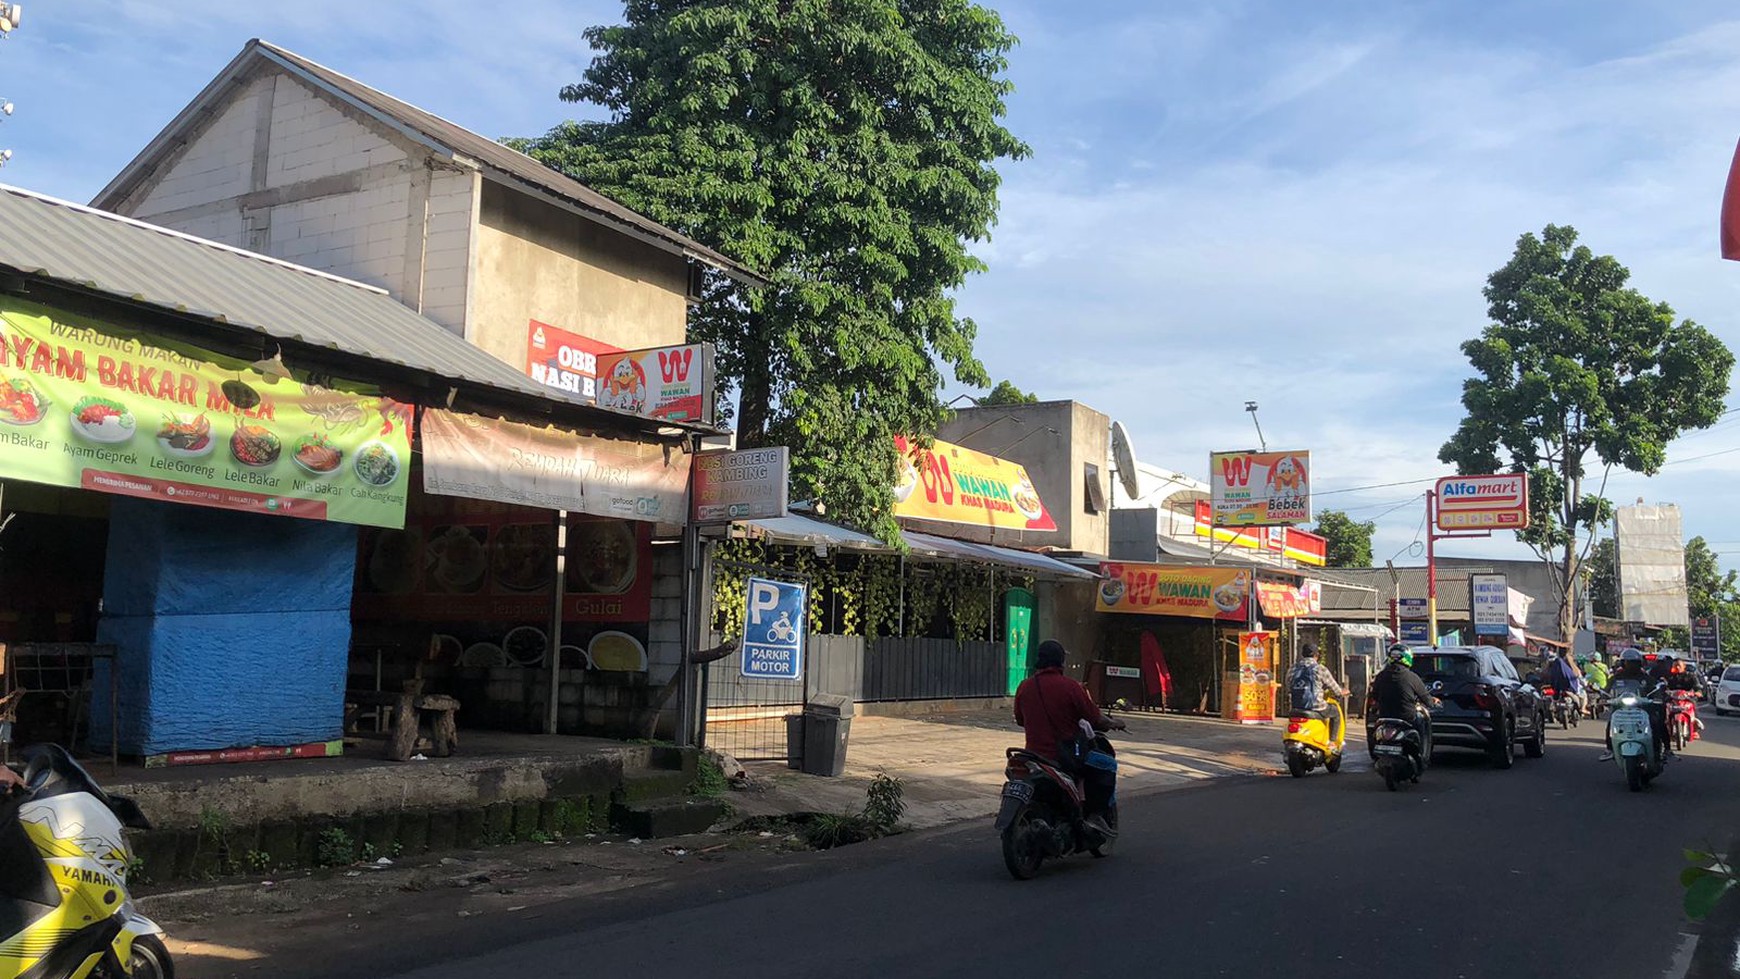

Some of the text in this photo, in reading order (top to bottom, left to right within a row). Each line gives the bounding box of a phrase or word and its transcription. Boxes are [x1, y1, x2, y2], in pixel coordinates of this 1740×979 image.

[50, 320, 201, 371] WARUNG MAKAN
[97, 354, 199, 408] BAKAR
[531, 362, 580, 394] NASI
[660, 387, 690, 397] WAWAN
[11, 432, 50, 450] Bakar
[63, 442, 138, 465] Ayam Geprek
[728, 451, 777, 467] GORENG
[150, 457, 215, 479] Lele Goreng
[708, 465, 767, 483] KAMBING
[225, 468, 281, 488] Lele Bakar
[953, 472, 1012, 502] WAWAN
[292, 479, 344, 497] Nila Bakar
[1443, 481, 1518, 496] Alfamart
[1268, 497, 1306, 510] Bebek
[1158, 583, 1211, 599] WAWAN
[576, 599, 623, 615] Gulai
[751, 582, 780, 625] P
[751, 648, 790, 661] PARKIR
[751, 660, 790, 673] MOTOR
[62, 864, 115, 887] YAMAH
